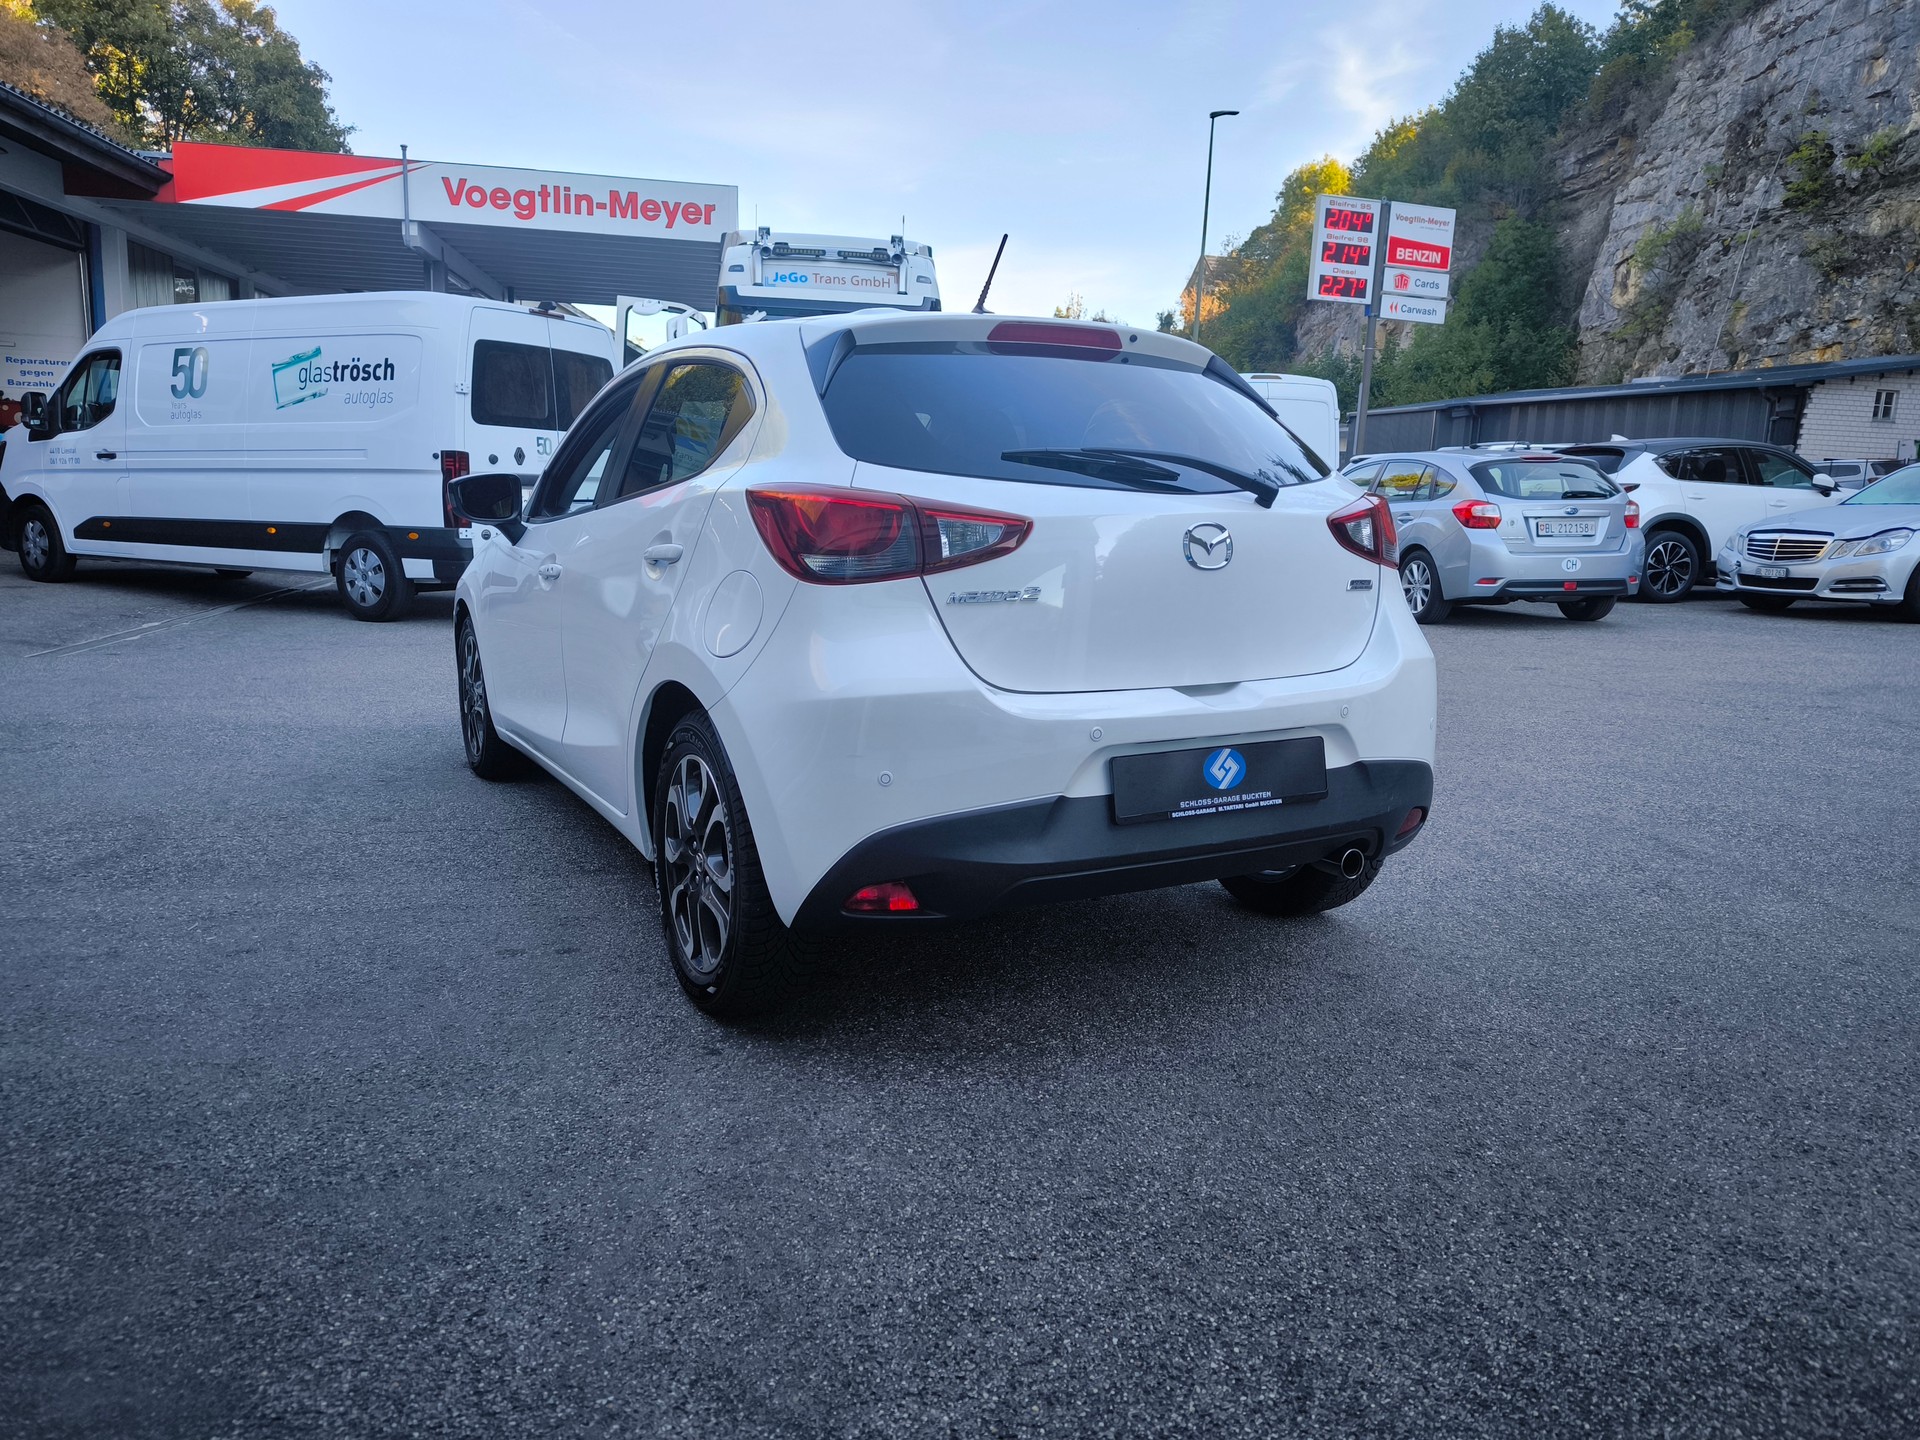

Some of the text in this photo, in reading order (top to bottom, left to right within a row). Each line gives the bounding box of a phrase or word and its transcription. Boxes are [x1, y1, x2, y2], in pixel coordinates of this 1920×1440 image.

[441, 176, 716, 229] Voegtlin-Meyer
[1396, 247, 1441, 264] BENZIN
[773, 272, 891, 289] JeGo Trans GmbH
[1414, 278, 1440, 290] Cards
[1400, 304, 1437, 317] Carwash
[20, 369, 54, 378] gegen
[170, 346, 210, 400] 50
[298, 357, 395, 391] glaströsch
[344, 388, 394, 409] autoglas
[170, 410, 202, 422] autoglas
[536, 436, 553, 456] 50
[1545, 523, 1589, 533] BL 212158
[1566, 559, 1578, 570] CH
[1180, 791, 1272, 808] SCHLOSS-GARAGE BUCKTEN
[1172, 807, 1216, 817] SCHLOSS-GARAGE
